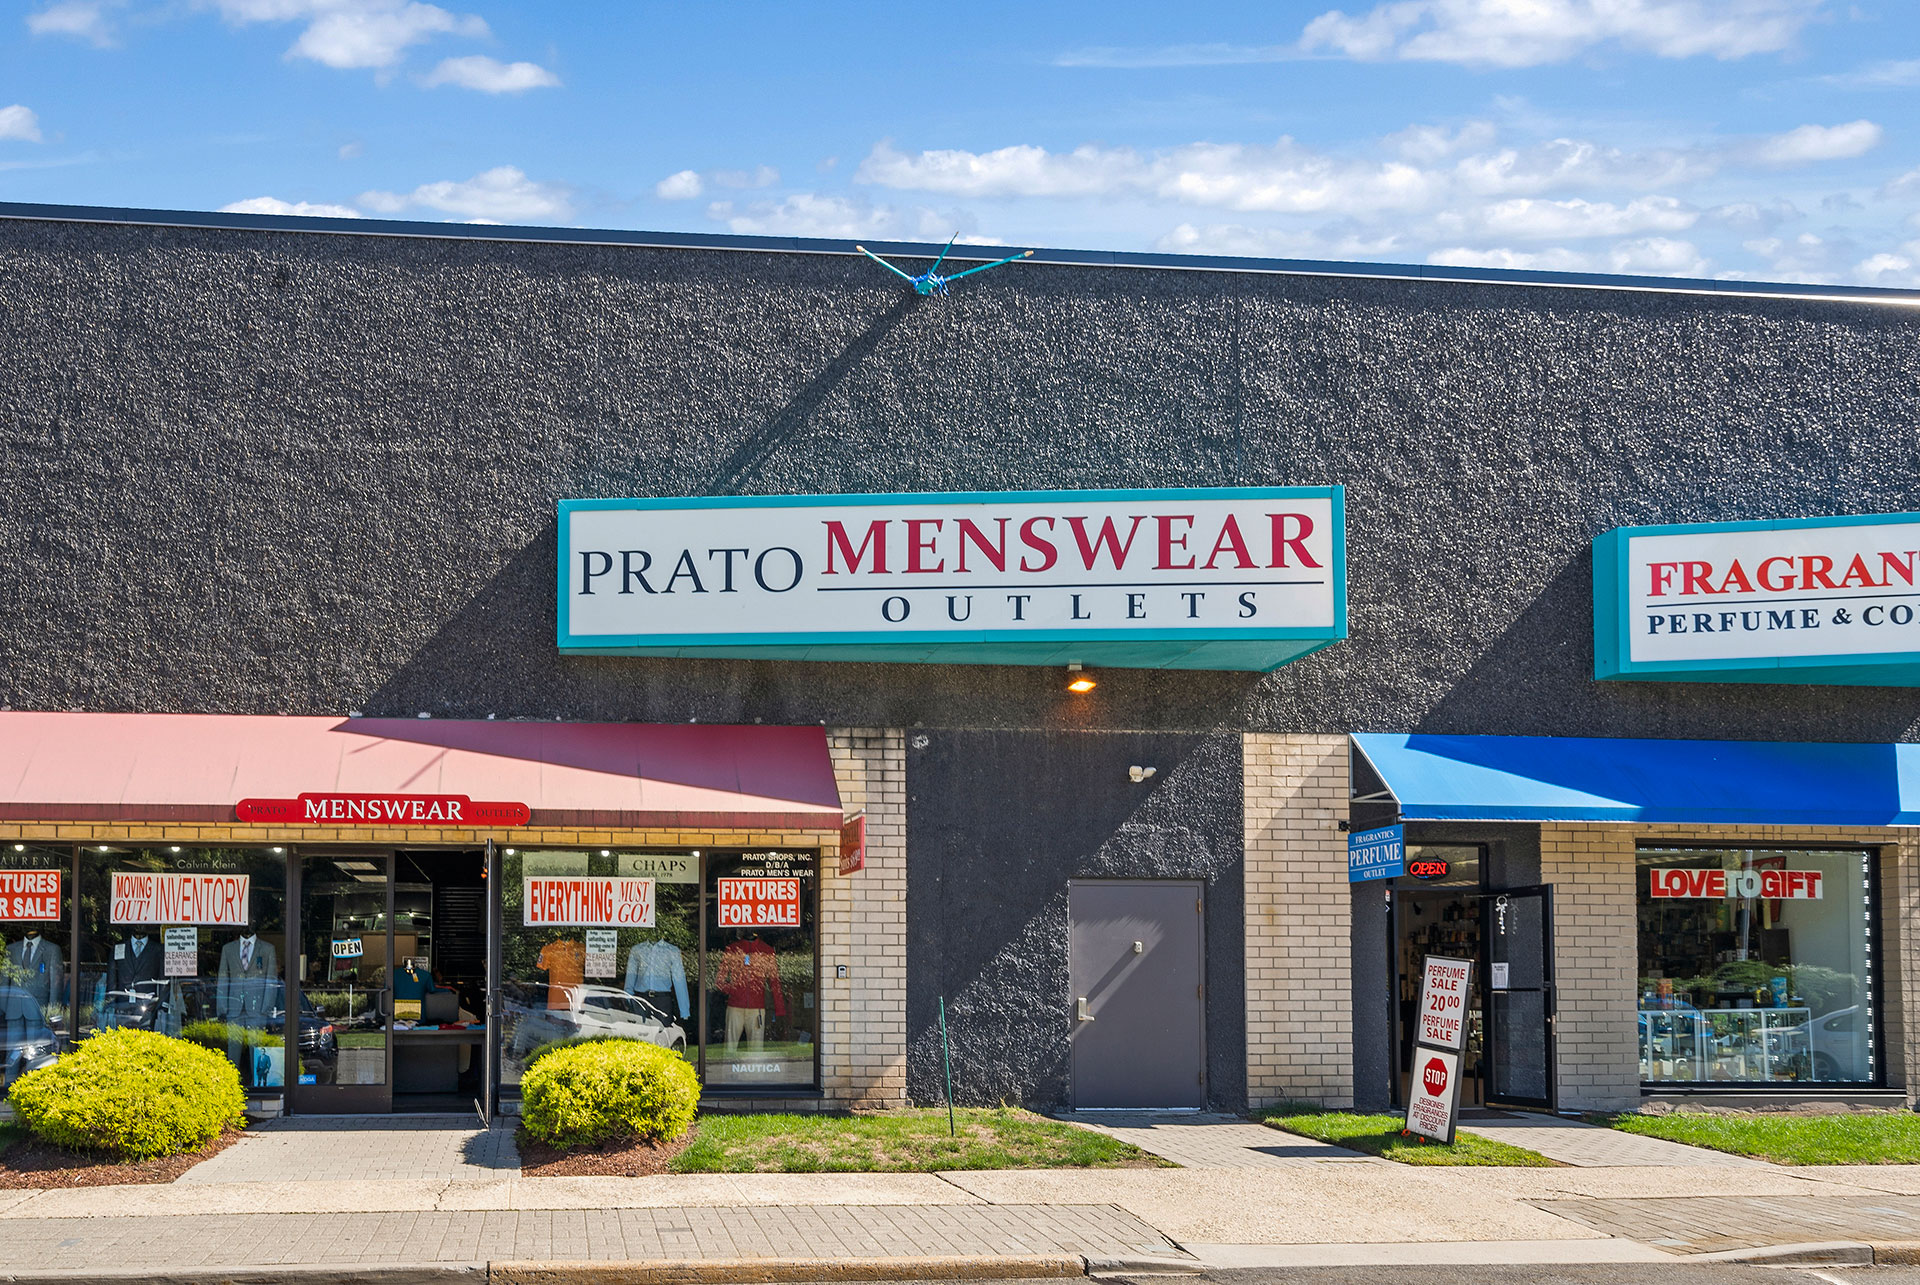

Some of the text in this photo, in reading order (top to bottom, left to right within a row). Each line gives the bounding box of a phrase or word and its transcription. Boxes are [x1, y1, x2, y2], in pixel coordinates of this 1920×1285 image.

[578, 513, 1323, 595] PRATO MENSWEAR
[1646, 551, 1920, 596] FRAGRAN
[883, 592, 1257, 621] OUTLETS
[1648, 603, 1920, 635] PERFUME & CO
[250, 799, 524, 820] PRATO MENSWEAR OUTLETS
[1355, 830, 1395, 844] FRAGRANTICS
[742, 853, 766, 861] PRATO
[768, 853, 796, 861] SHOPS,
[1350, 842, 1401, 867] PERFUME
[177, 859, 237, 869] Calvin Klein
[633, 860, 687, 871] CHAPS
[741, 869, 765, 877] PRATO
[766, 869, 790, 877] MEN'S
[765, 861, 789, 869] D/B/A
[1363, 867, 1386, 879] OUTLET
[1410, 861, 1447, 875] OPEN
[0, 873, 57, 894] TURES
[116, 875, 152, 899] MOVING
[619, 881, 650, 902] MUST
[721, 881, 797, 900] FIXTURES
[1651, 869, 1725, 897] LOVE
[1761, 871, 1822, 898] GIFT
[13, 897, 57, 917] SALE
[155, 877, 247, 922] INVENTORY
[530, 881, 613, 923] EVERYTHING
[114, 899, 150, 921] OUT!
[617, 903, 650, 923] GO!
[721, 904, 797, 923] FOR SALE
[165, 951, 196, 960] CLEARANCE
[333, 942, 361, 954] OPEN
[1428, 964, 1466, 980] PERFUME
[1431, 977, 1458, 991] SALE
[1423, 1013, 1460, 1031] PERFUME
[1426, 1027, 1452, 1041] SALE
[731, 1064, 781, 1072] NAUTICA
[1425, 1068, 1446, 1086] STOP
[1413, 1103, 1448, 1120] FRAGRANCES
[1419, 1096, 1445, 1110] DESIGNER
[1412, 1111, 1446, 1126] AT DISCOUNT
[1419, 1120, 1438, 1133] PRICES
